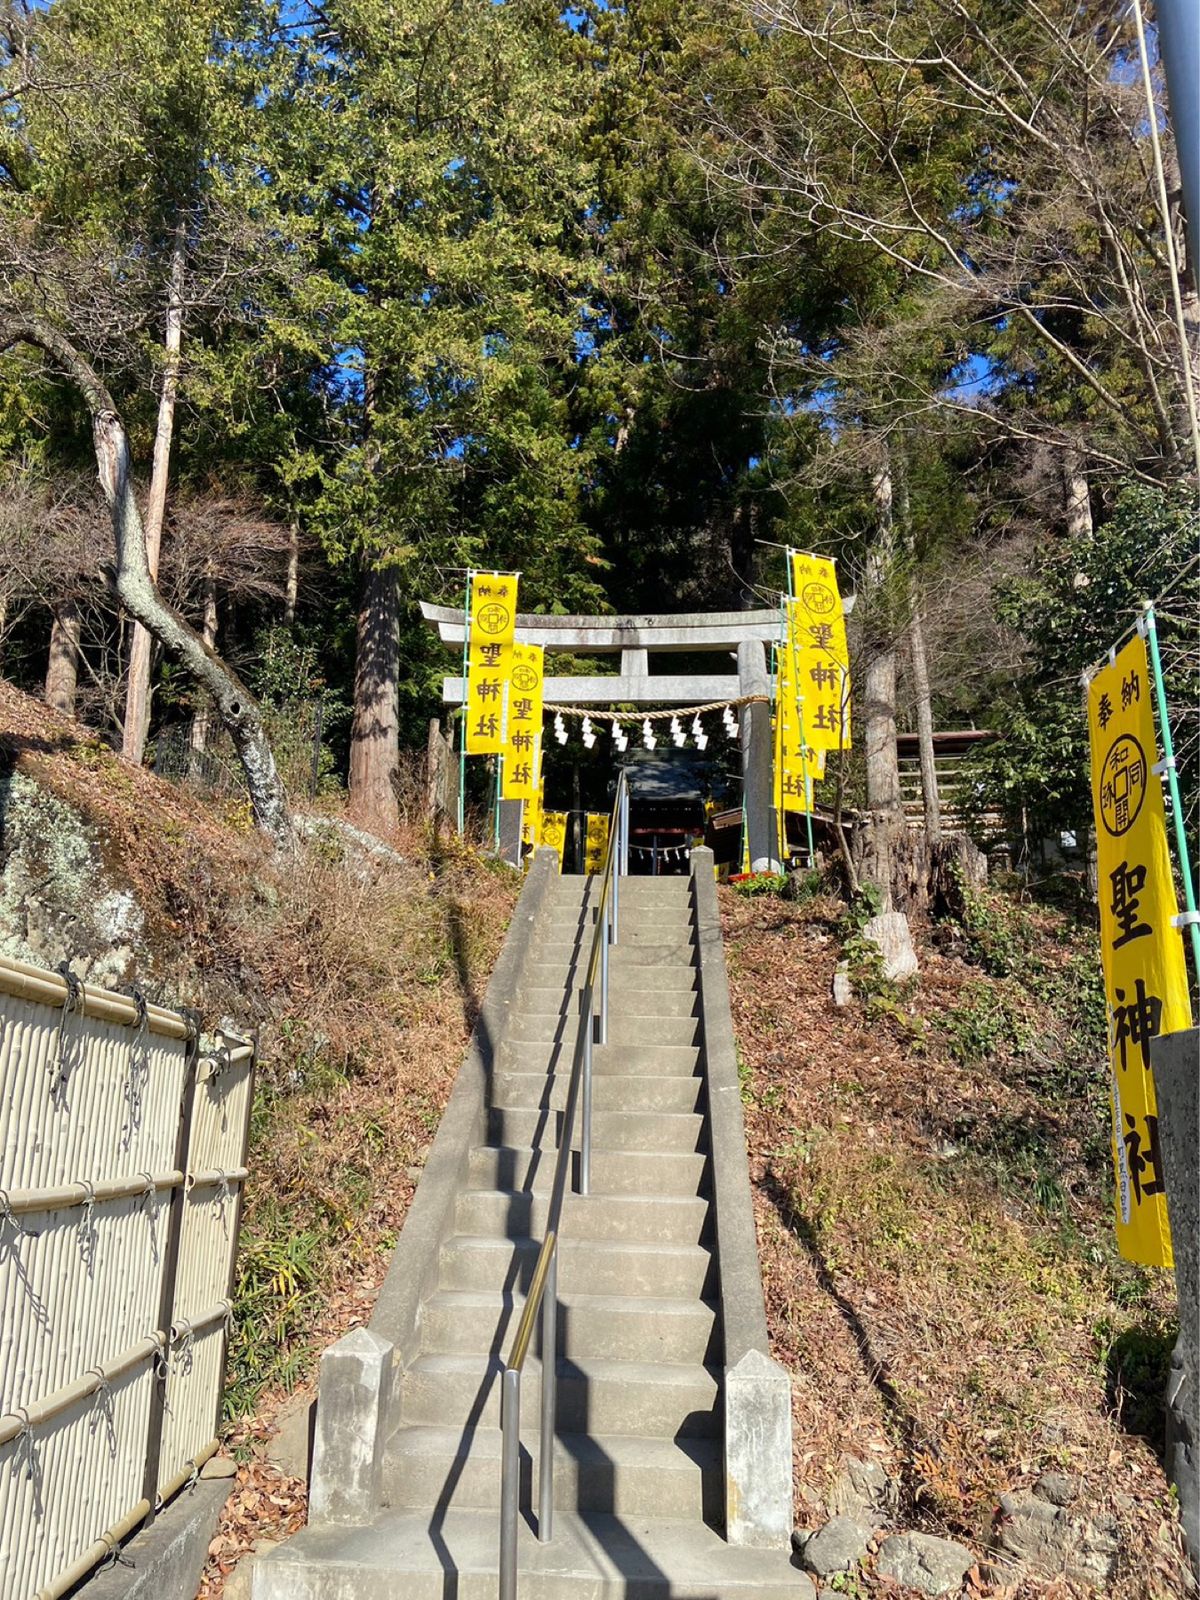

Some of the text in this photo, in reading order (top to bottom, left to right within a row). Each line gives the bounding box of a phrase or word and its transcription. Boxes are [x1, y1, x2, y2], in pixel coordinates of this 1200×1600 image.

[1097, 669, 1140, 731] 奉納
[1109, 860, 1166, 1206] 聖神社
